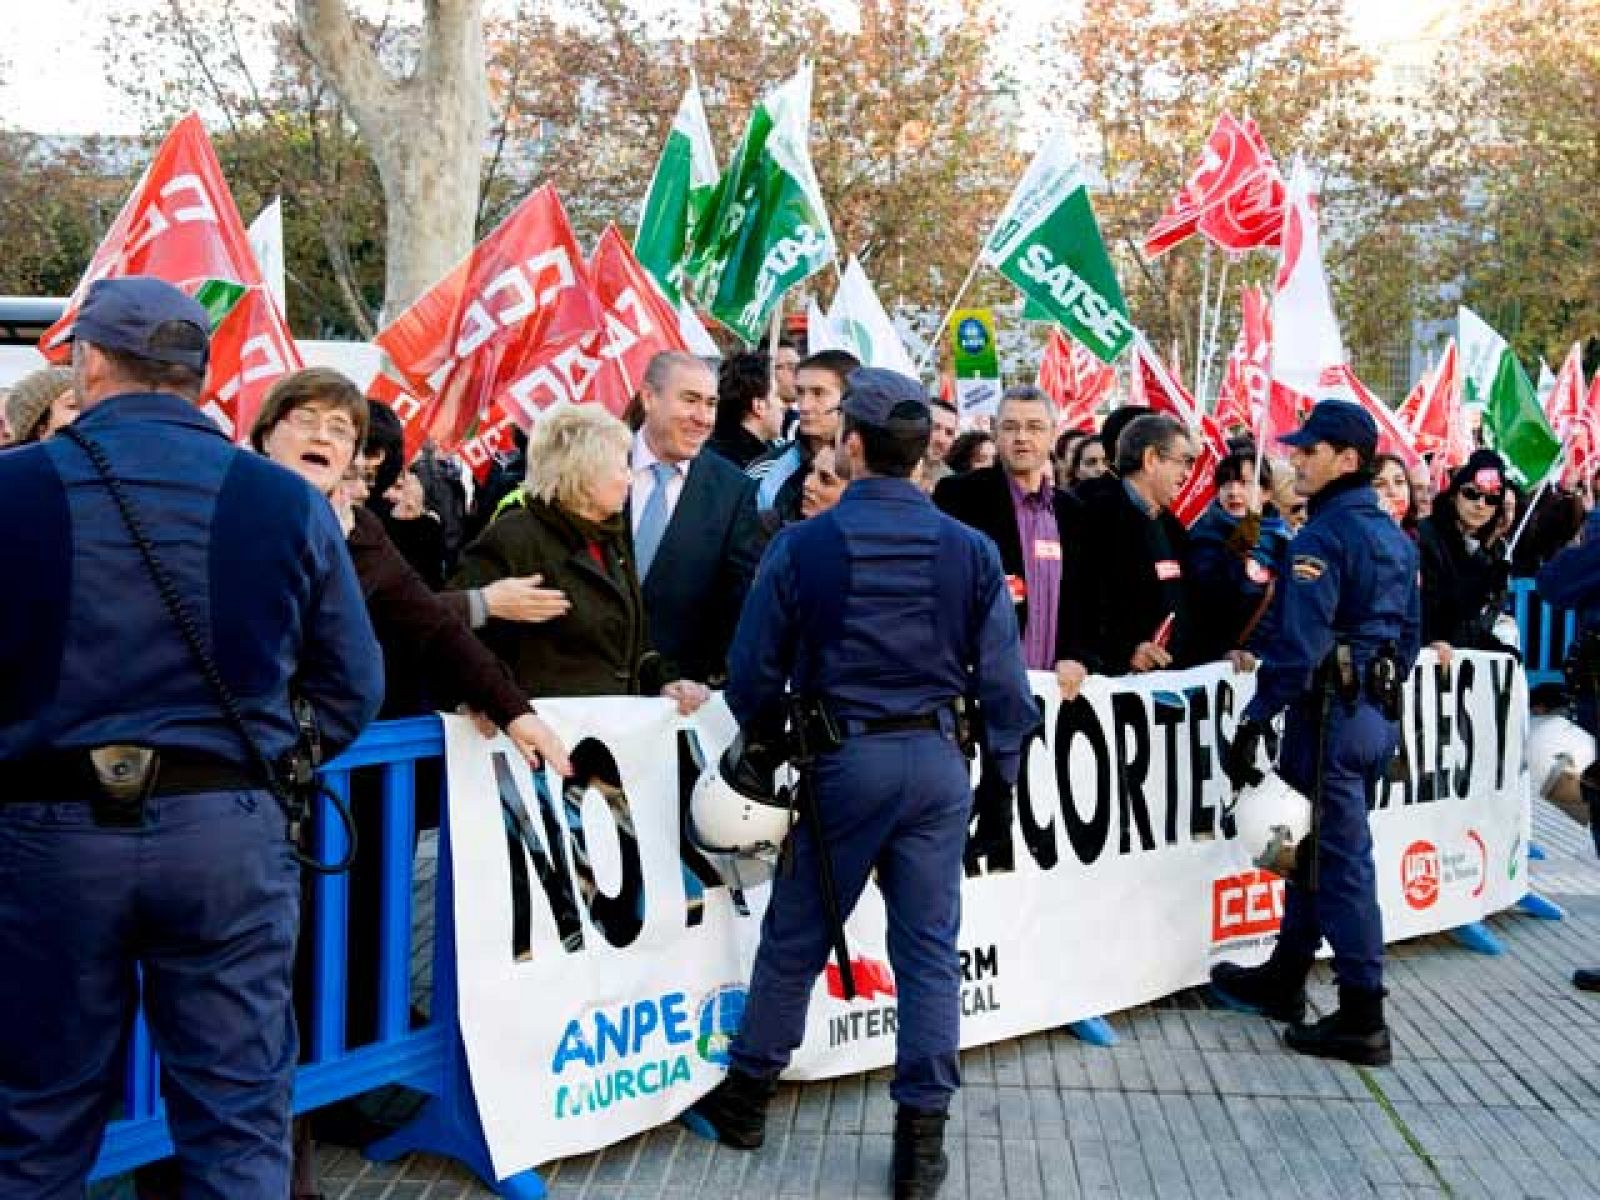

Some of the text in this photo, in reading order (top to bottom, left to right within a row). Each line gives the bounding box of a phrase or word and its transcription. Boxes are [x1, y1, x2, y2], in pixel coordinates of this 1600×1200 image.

[1016, 243, 1134, 349] SATSE
[491, 737, 645, 961] NO
[1489, 659, 1514, 791] Y
[552, 991, 693, 1074] ANPE
[554, 1056, 692, 1119] MURCIA
